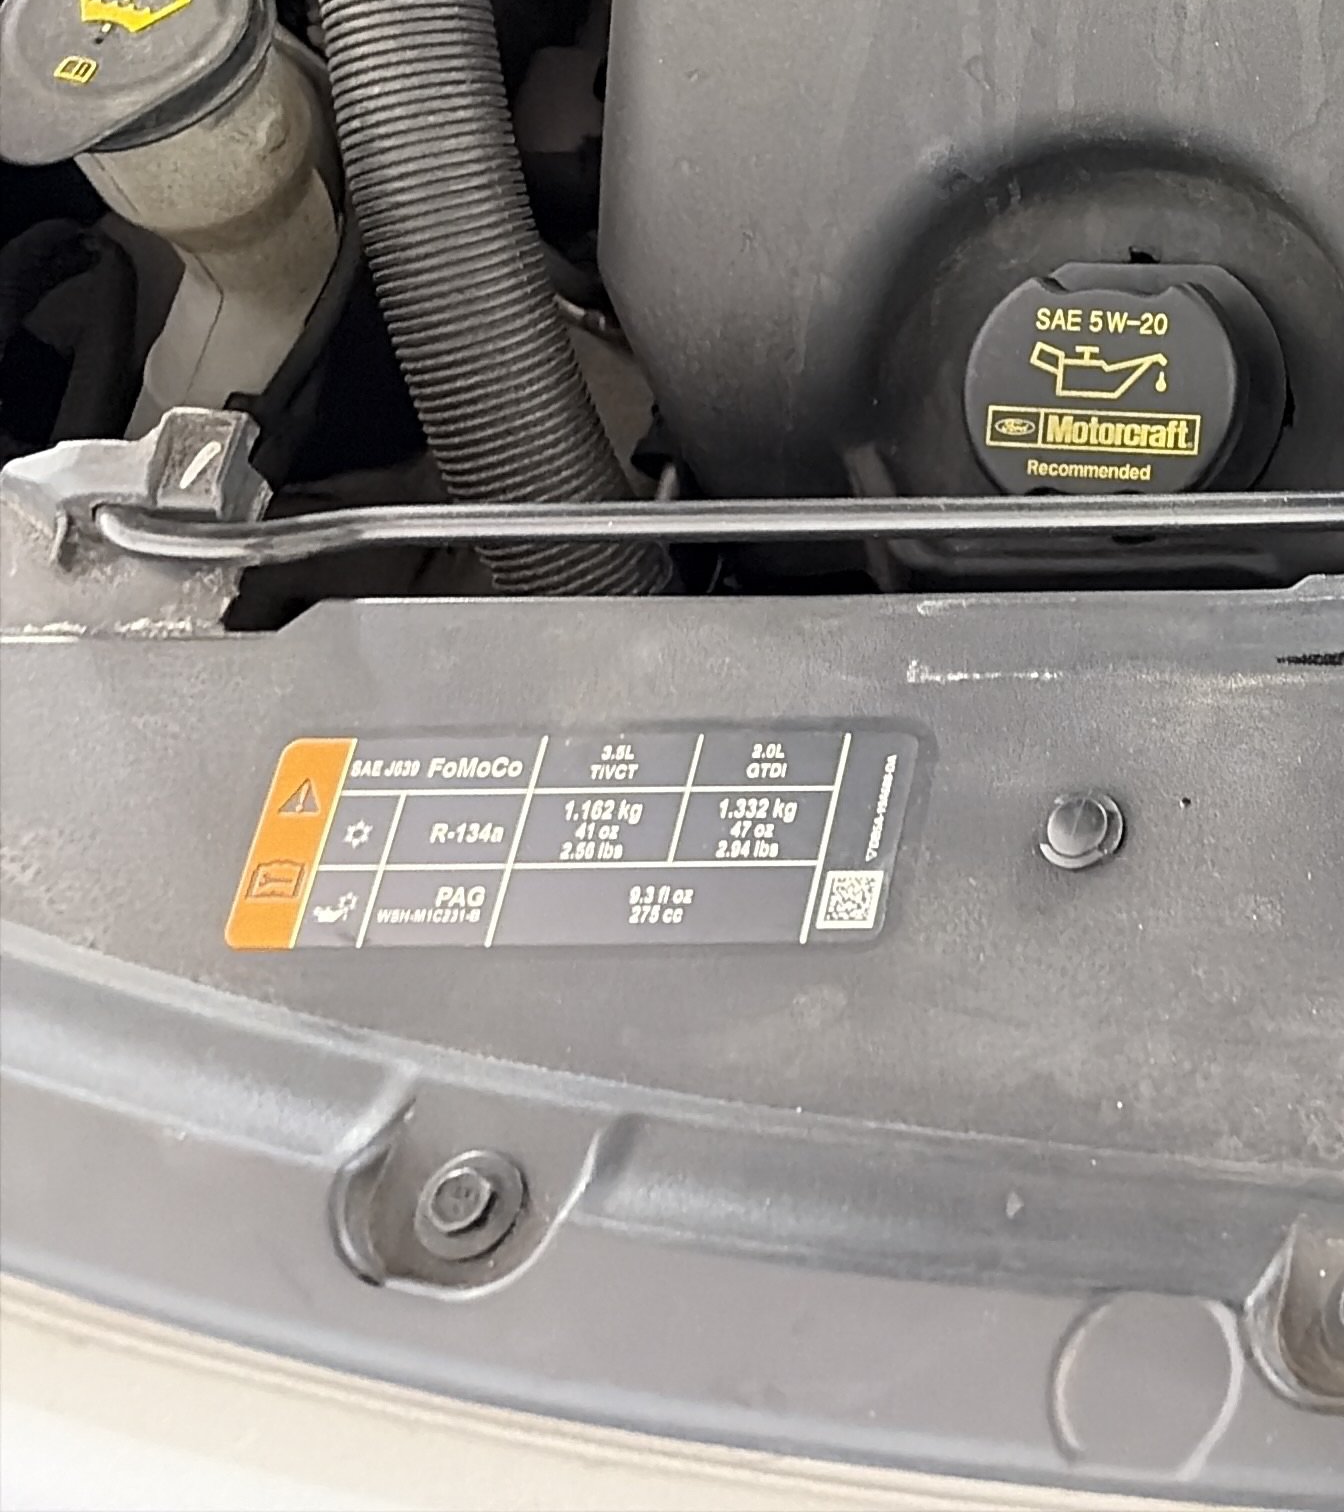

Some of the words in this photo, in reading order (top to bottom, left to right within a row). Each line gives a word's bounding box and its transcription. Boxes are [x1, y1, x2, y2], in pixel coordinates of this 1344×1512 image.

[1035, 307, 1083, 332] SAE
[1089, 310, 1168, 336] 5W-20
[1046, 414, 1189, 449] Motorcraft
[1026, 459, 1151, 481] Recommended
[751, 743, 785, 759] 2.0L
[427, 756, 523, 779] FoMoCo
[564, 799, 615, 821] 1.162
[617, 799, 644, 825] kg
[719, 798, 770, 820] 1.332
[772, 798, 798, 824] kg
[429, 822, 504, 844] R-134a
[575, 822, 596, 840] 41
[598, 824, 620, 840] oz
[730, 820, 752, 838] 47
[753, 823, 775, 838] oz
[597, 841, 624, 860] lbs
[753, 839, 779, 858] lbs
[435, 885, 486, 908] PAG
[629, 886, 656, 905] 9.3
[672, 887, 694, 905] oz
[629, 906, 661, 924] 275
[662, 908, 684, 924] cc
